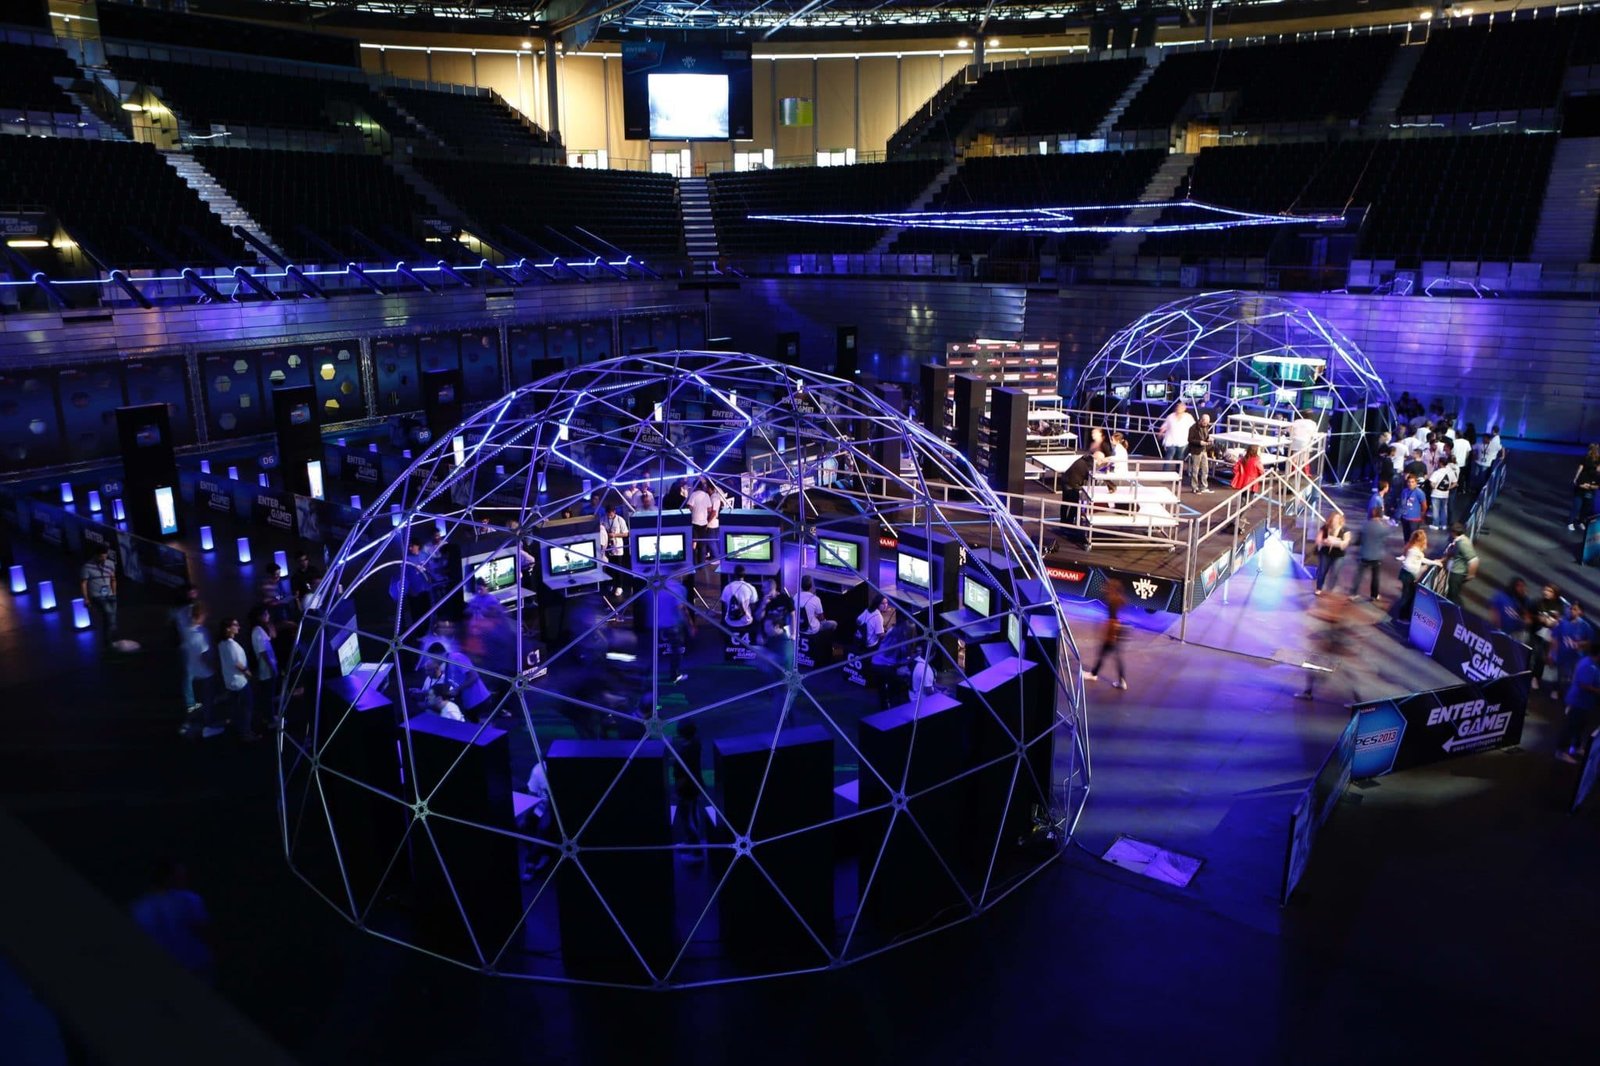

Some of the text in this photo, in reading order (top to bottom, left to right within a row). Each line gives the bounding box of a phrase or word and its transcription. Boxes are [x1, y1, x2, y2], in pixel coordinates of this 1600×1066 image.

[262, 456, 274, 465] D6
[105, 482, 118, 493] D4
[257, 494, 280, 508] ENTER
[1047, 569, 1079, 582] KONAMI
[1453, 623, 1494, 658] ENTER
[526, 649, 541, 666] C1
[1426, 699, 1502, 727] ENTER THE
[1457, 713, 1505, 738] GAME
[1355, 731, 1397, 747] PES 2013
